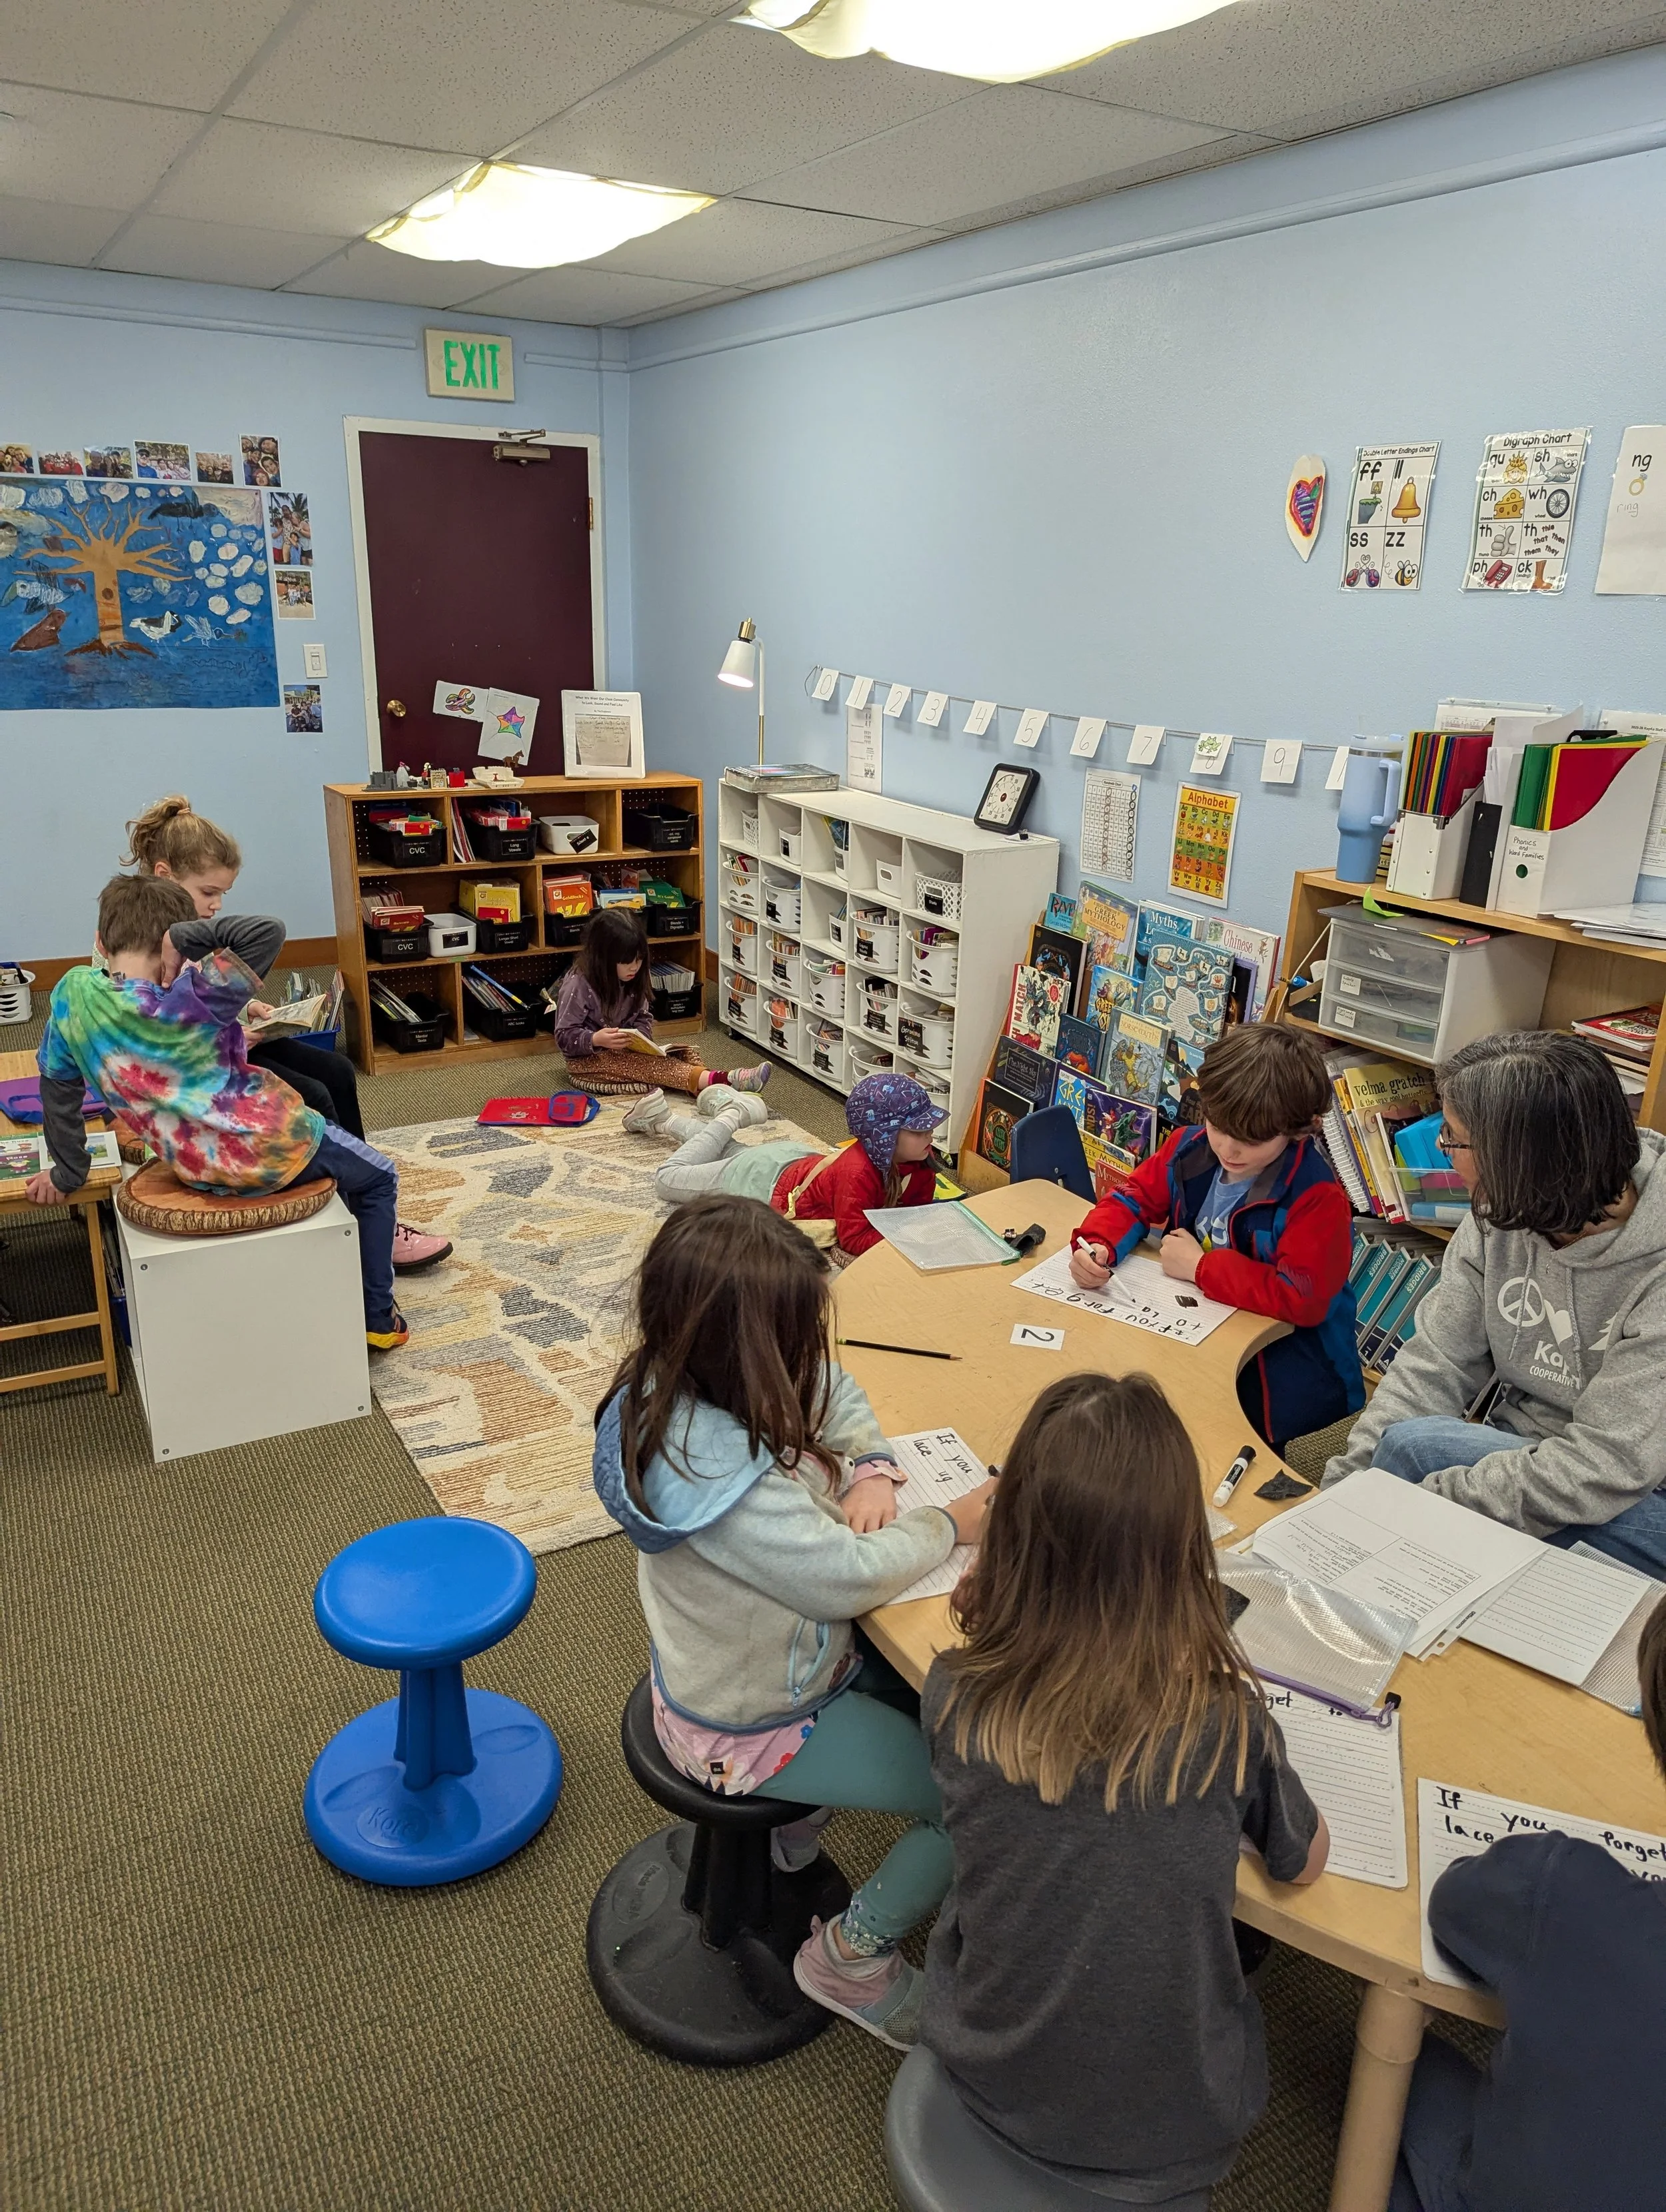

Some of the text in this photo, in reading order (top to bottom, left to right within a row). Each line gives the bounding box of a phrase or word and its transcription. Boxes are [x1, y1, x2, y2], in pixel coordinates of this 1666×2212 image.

[444, 340, 500, 389] EXIT
[1503, 433, 1572, 448] Digraph Chart
[1490, 453, 1505, 468] qu
[1535, 448, 1550, 462] sh
[1632, 453, 1652, 472] ng
[1359, 461, 1382, 481] ff
[1394, 460, 1404, 479] ll
[1483, 488, 1497, 502] ch
[1529, 486, 1547, 500] wh
[1617, 501, 1639, 518] ring
[1479, 524, 1492, 537] th
[1523, 523, 1537, 536] th
[1350, 532, 1368, 547] ss
[1386, 532, 1405, 548] zz
[1533, 535, 1548, 544] that
[1524, 546, 1541, 556] them
[1545, 544, 1559, 557] they
[1472, 560, 1488, 574] ph
[1517, 560, 1533, 573] ck
[820, 674, 832, 695] 0
[854, 680, 864, 706] 1
[889, 691, 902, 713] 2
[926, 699, 940, 721] 3
[975, 707, 988, 732] 4
[1022, 717, 1038, 743] 5
[1079, 727, 1094, 751] 6
[1140, 736, 1153, 756] 7
[1273, 747, 1286, 776] 9
[1188, 792, 1229, 809] Alphabet
[1513, 836, 1537, 846] Phonics
[1521, 851, 1544, 860] Families
[1084, 908, 1126, 931] MYTHOLOGY
[1094, 907, 1117, 921] GREEK
[1150, 911, 1180, 931] Myths,
[1224, 929, 1253, 953] Chinese
[1014, 983, 1027, 1023] MATCH
[901, 1026, 920, 1037] Geronimo
[904, 1035, 919, 1046] Stilton
[1017, 1061, 1028, 1073] Night
[1354, 1073, 1425, 1097] velma gratch
[1162, 1126, 1172, 1137] THE
[1369, 1249, 1387, 1277] BRIDGES
[1390, 1258, 1405, 1280] NUMBER
[1407, 1265, 1427, 1293] BRIDGES
[1021, 1328, 1055, 1343] 2
[1529, 1365, 1575, 1388] COOPERATIVE
[913, 1438, 932, 1457] lace
[936, 1433, 973, 1474] If you
[1329, 1707, 1343, 1716] to
[1436, 1786, 1666, 1862] If you forget
[1445, 1814, 1495, 1844] lace
